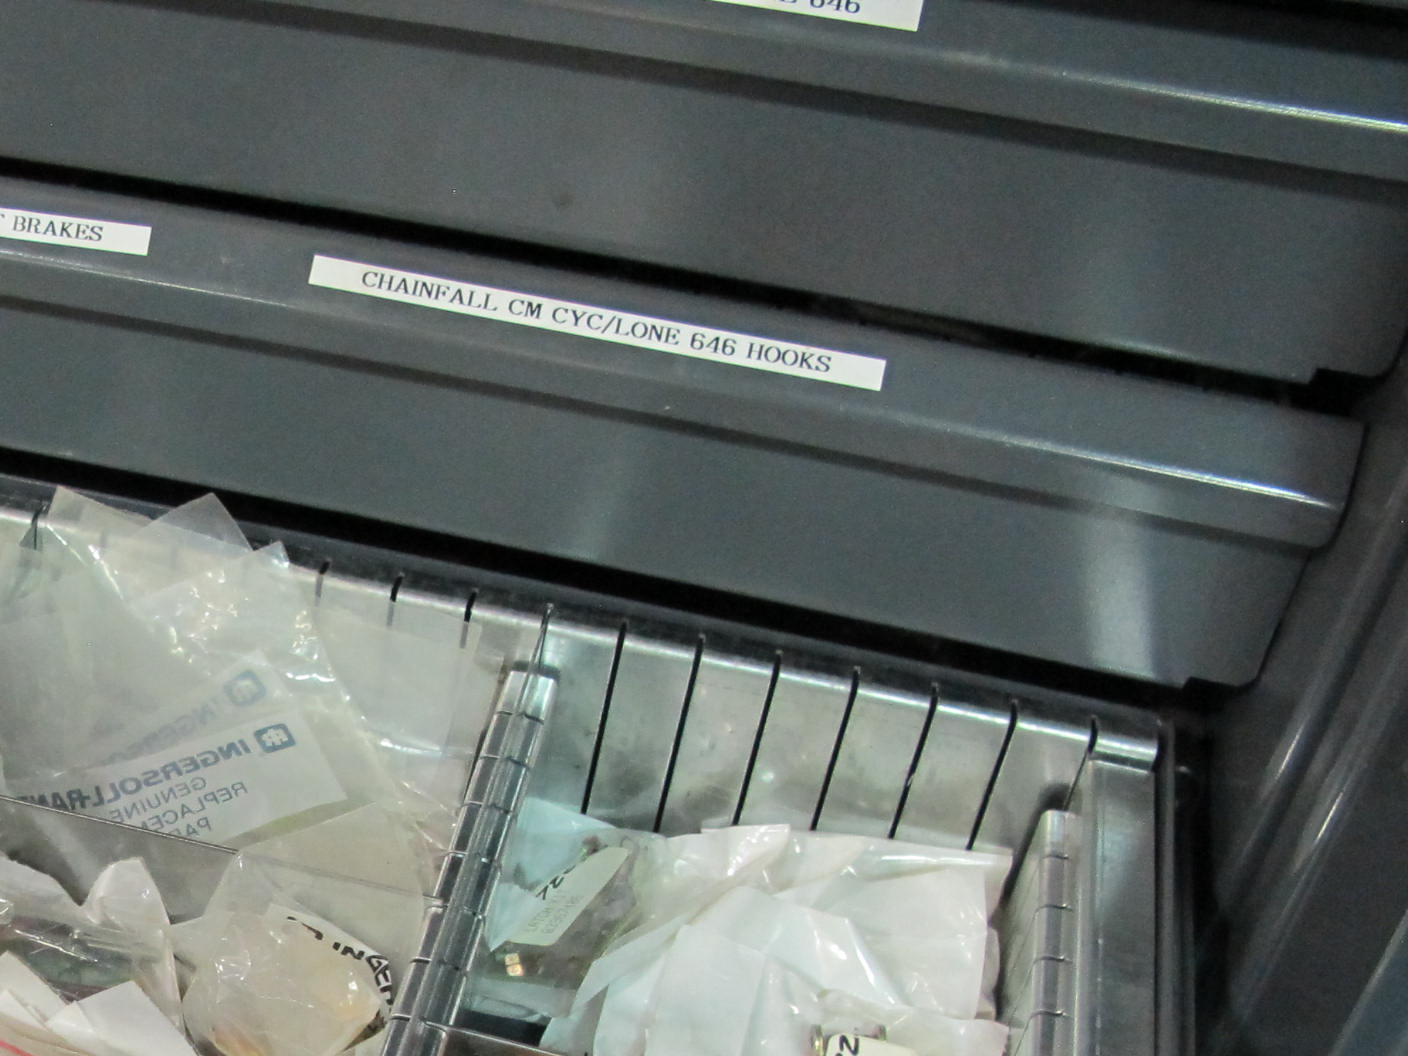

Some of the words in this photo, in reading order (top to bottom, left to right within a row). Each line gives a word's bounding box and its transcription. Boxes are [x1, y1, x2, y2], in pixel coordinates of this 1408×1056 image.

[12, 215, 104, 242] BRAKES
[361, 271, 498, 313] CHAINFALL
[508, 299, 544, 319] CM
[551, 306, 681, 346] CYC/LONE
[689, 332, 737, 357] 646
[746, 341, 832, 373] HOOKS
